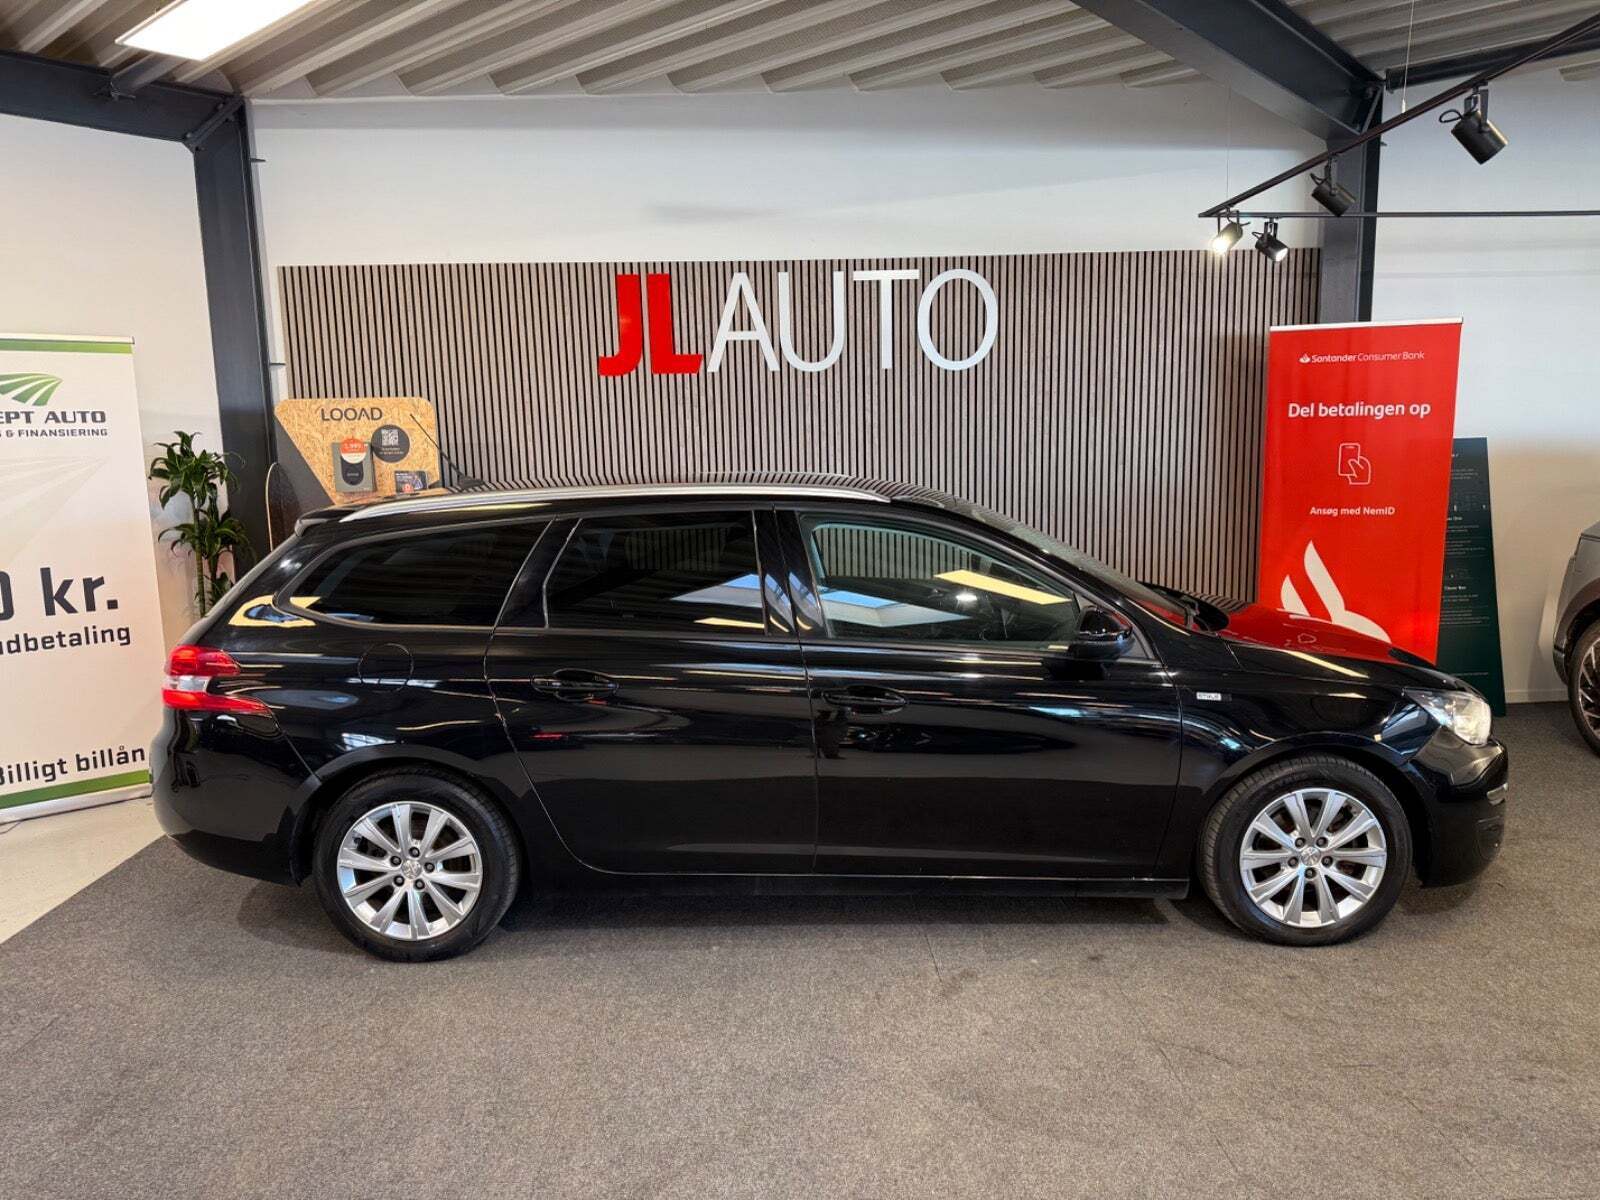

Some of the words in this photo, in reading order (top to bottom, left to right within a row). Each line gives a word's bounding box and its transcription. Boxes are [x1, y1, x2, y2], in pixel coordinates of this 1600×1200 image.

[597, 273, 704, 377] JL
[707, 268, 999, 373] AUTO
[1311, 353, 1357, 363] Santander
[1358, 352, 1401, 362] Consumer
[1403, 351, 1425, 361] Bank
[44, 410, 107, 424] AUTO
[320, 407, 383, 422] LOOAD
[1288, 403, 1314, 418] Del
[1318, 402, 1405, 420] betalingen
[1409, 403, 1431, 419] op
[18, 428, 108, 438] FINANSIERING
[1310, 506, 1338, 517] Ansøg
[1340, 506, 1361, 516] med
[1362, 506, 1396, 516] NemID
[40, 567, 119, 616] kr.
[0, 625, 131, 655] dbetaling
[75, 745, 145, 772] billån
